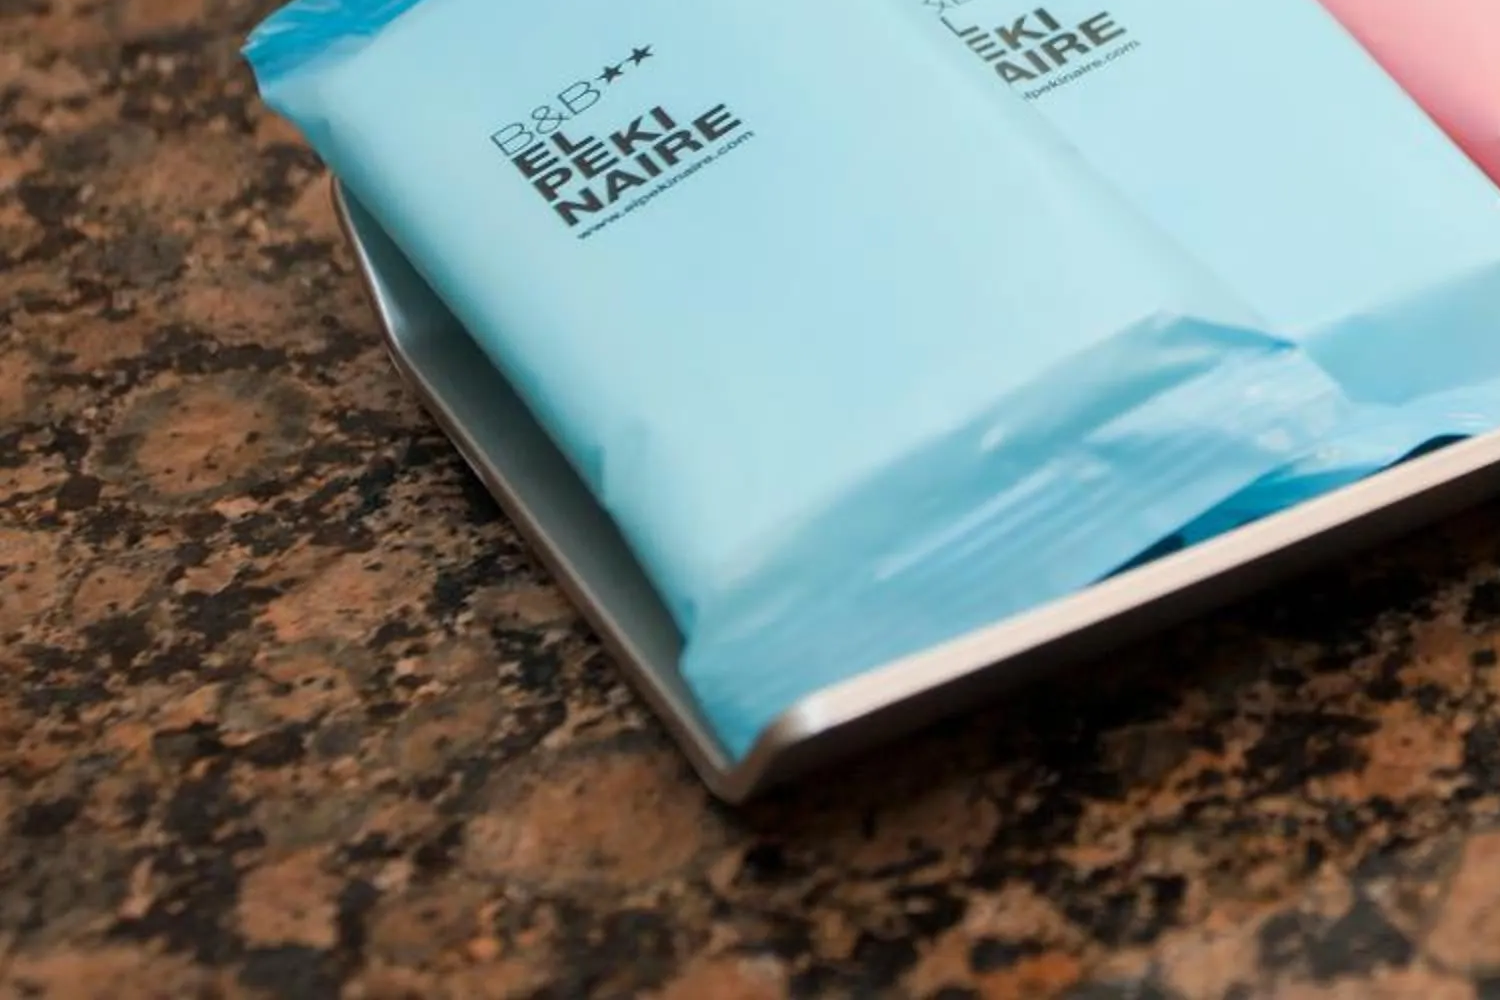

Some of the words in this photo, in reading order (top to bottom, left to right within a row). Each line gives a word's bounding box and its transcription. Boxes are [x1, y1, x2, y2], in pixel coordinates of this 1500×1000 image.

[939, 15, 981, 39] L
[964, 6, 1062, 63] EKI
[993, 10, 1128, 85] AIRE
[489, 80, 602, 157] B&B
[510, 130, 596, 180] EL
[531, 104, 678, 203] PEKI
[552, 102, 743, 228] NAIRE
[576, 129, 756, 240] www.elpekinaire.com
